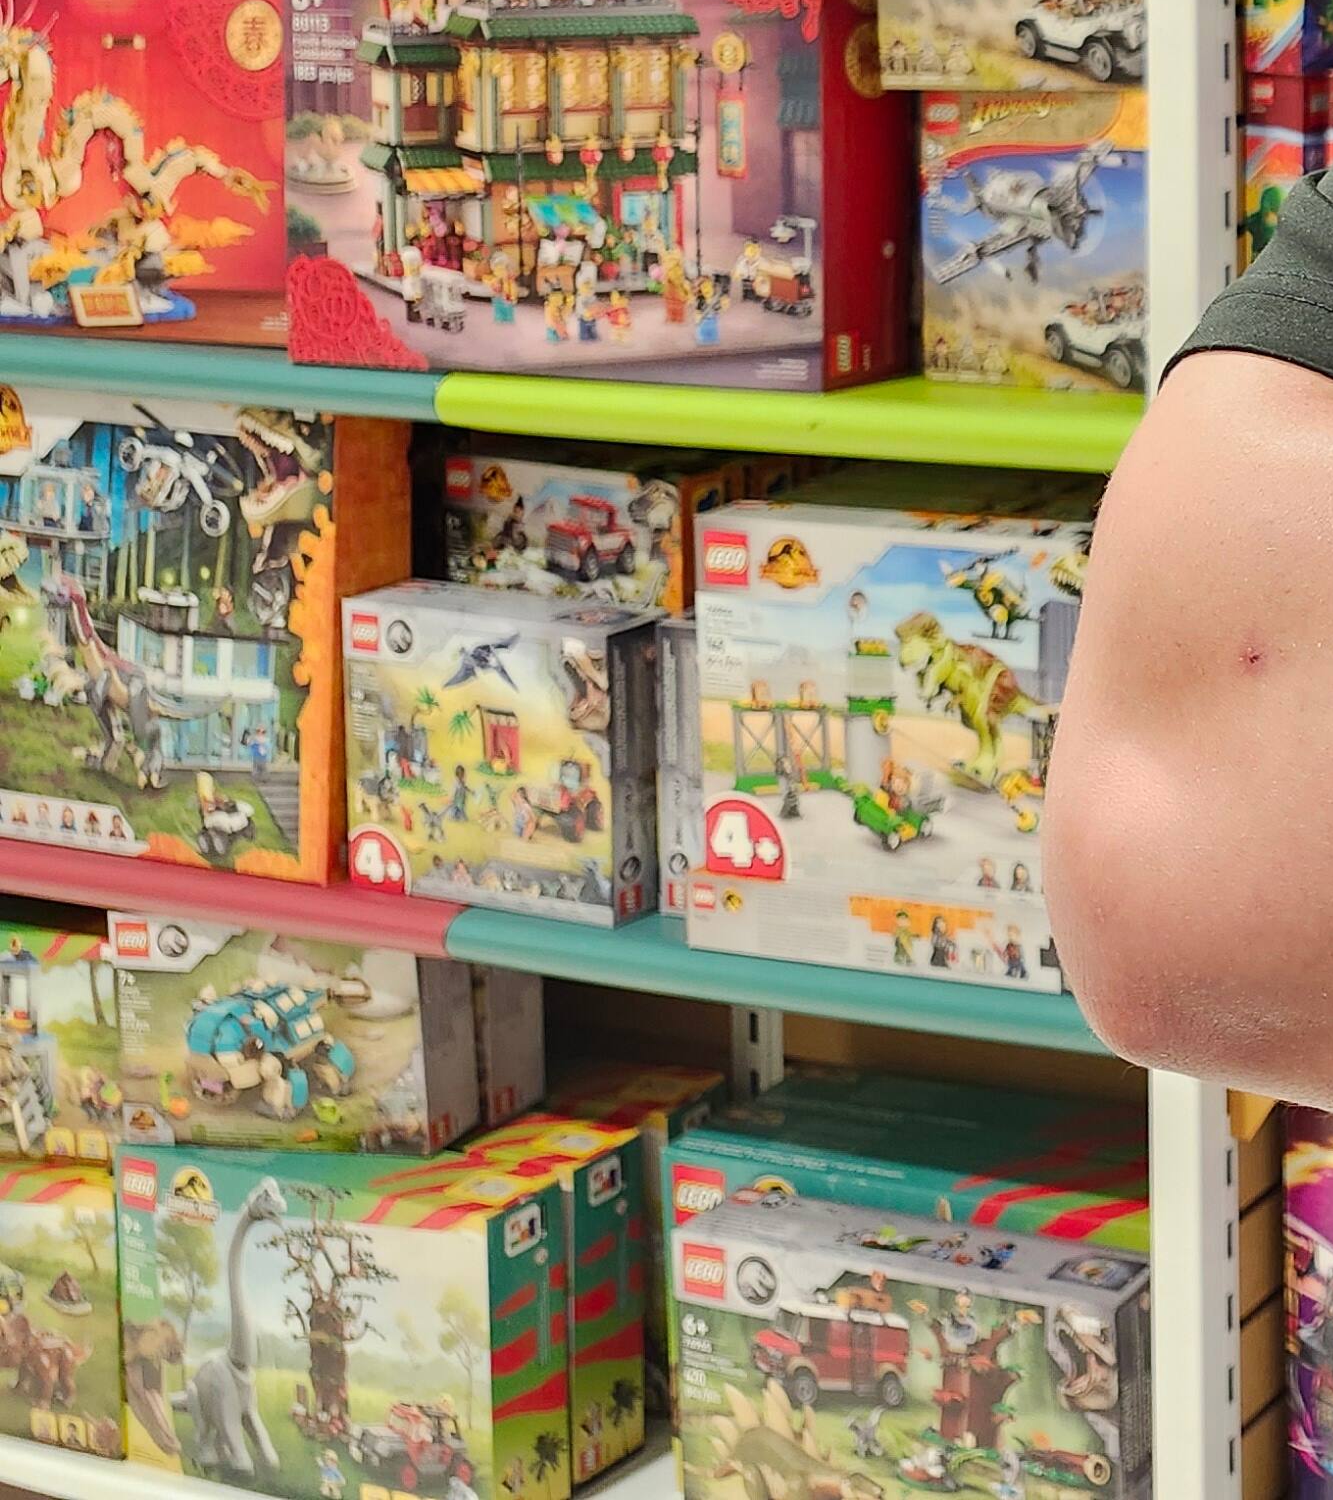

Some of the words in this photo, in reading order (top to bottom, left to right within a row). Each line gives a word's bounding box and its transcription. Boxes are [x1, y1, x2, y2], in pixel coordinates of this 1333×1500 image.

[705, 544, 748, 575] LEGO
[710, 811, 781, 868] 4+
[355, 839, 403, 884] 4+
[676, 1181, 723, 1212] LEGO
[684, 1257, 725, 1285] LEGO
